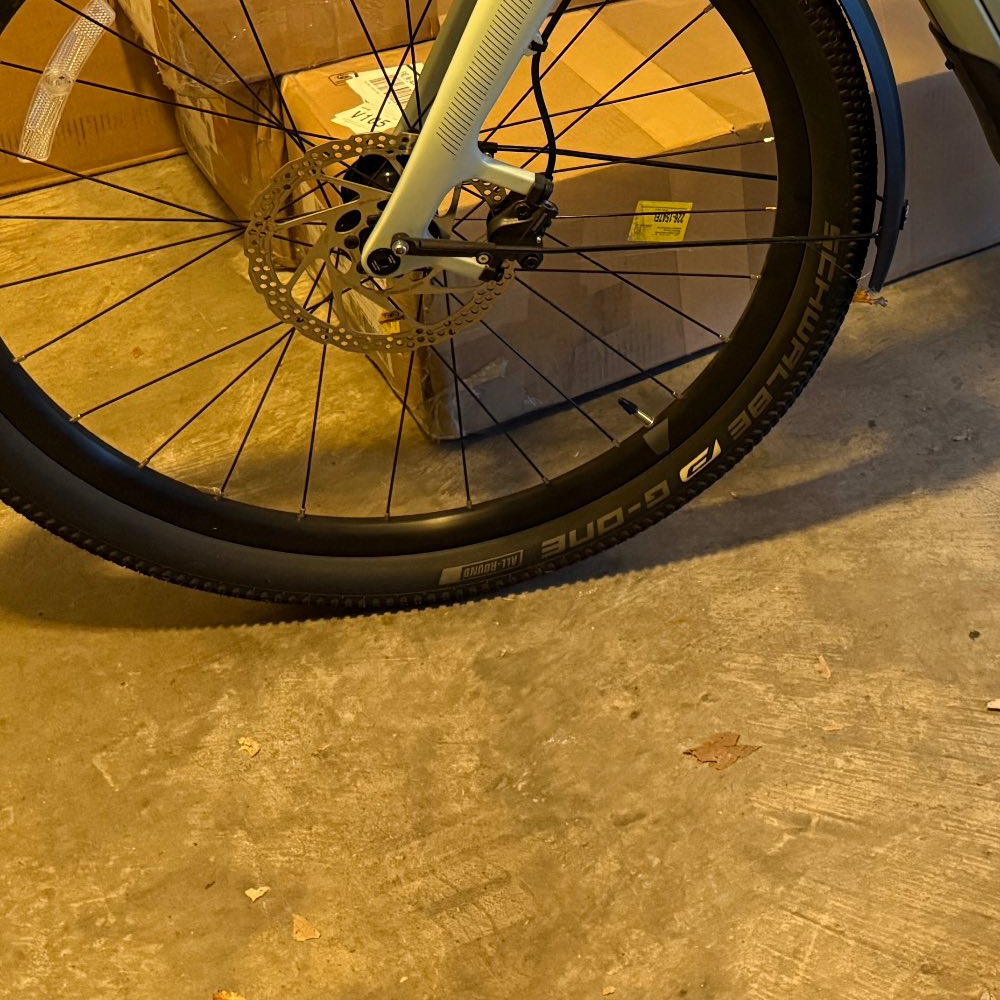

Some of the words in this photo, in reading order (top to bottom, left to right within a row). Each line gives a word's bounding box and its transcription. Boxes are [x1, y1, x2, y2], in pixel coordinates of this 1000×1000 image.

[728, 219, 842, 439] SCHWALBE
[541, 479, 671, 556] G-ONE
[462, 550, 519, 580] ALL-ROUND
